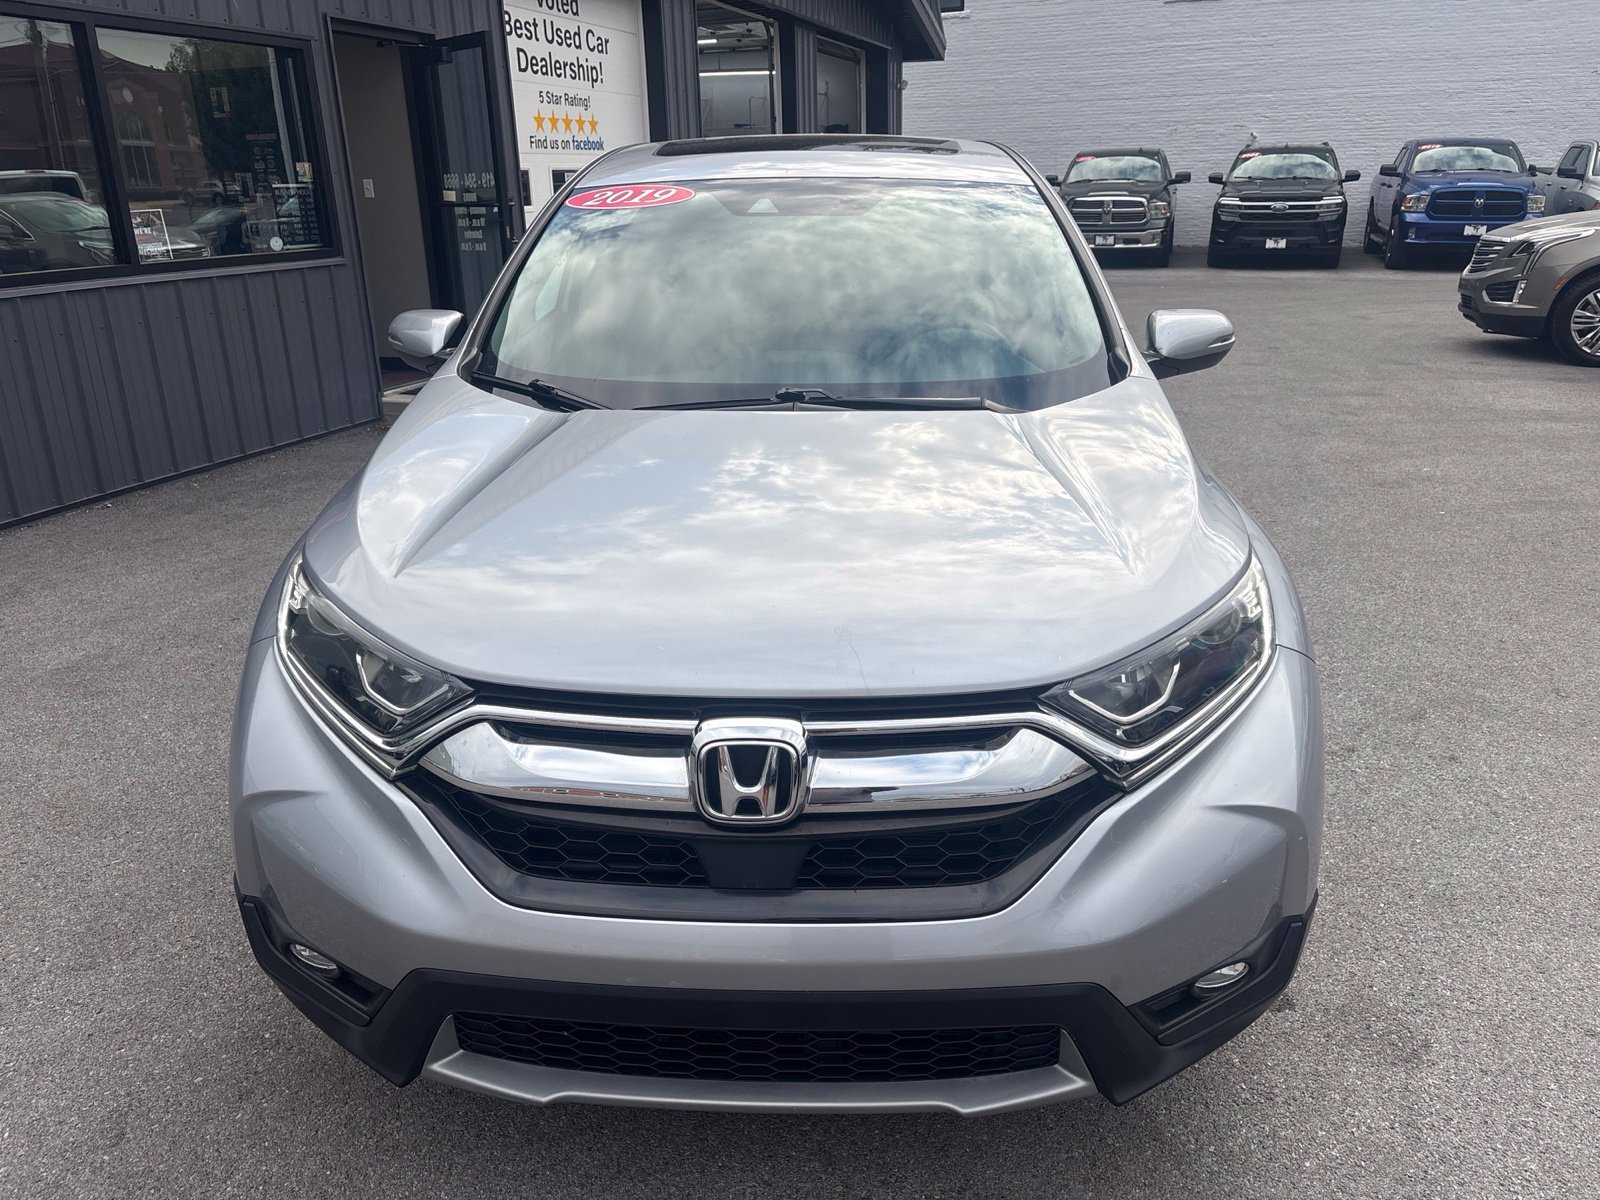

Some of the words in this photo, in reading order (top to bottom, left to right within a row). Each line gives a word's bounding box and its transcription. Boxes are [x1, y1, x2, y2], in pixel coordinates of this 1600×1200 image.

[504, 10, 540, 41] Best
[543, 18, 582, 50] Used
[585, 28, 609, 55] Car
[516, 47, 603, 88] Dealership!
[539, 90, 544, 104] 5
[546, 91, 562, 105] Star
[564, 93, 591, 111] Rating!
[529, 134, 548, 149] Find
[550, 138, 559, 150] us
[561, 139, 571, 150] on
[572, 135, 605, 151] facebook
[582, 188, 677, 206] 2019
